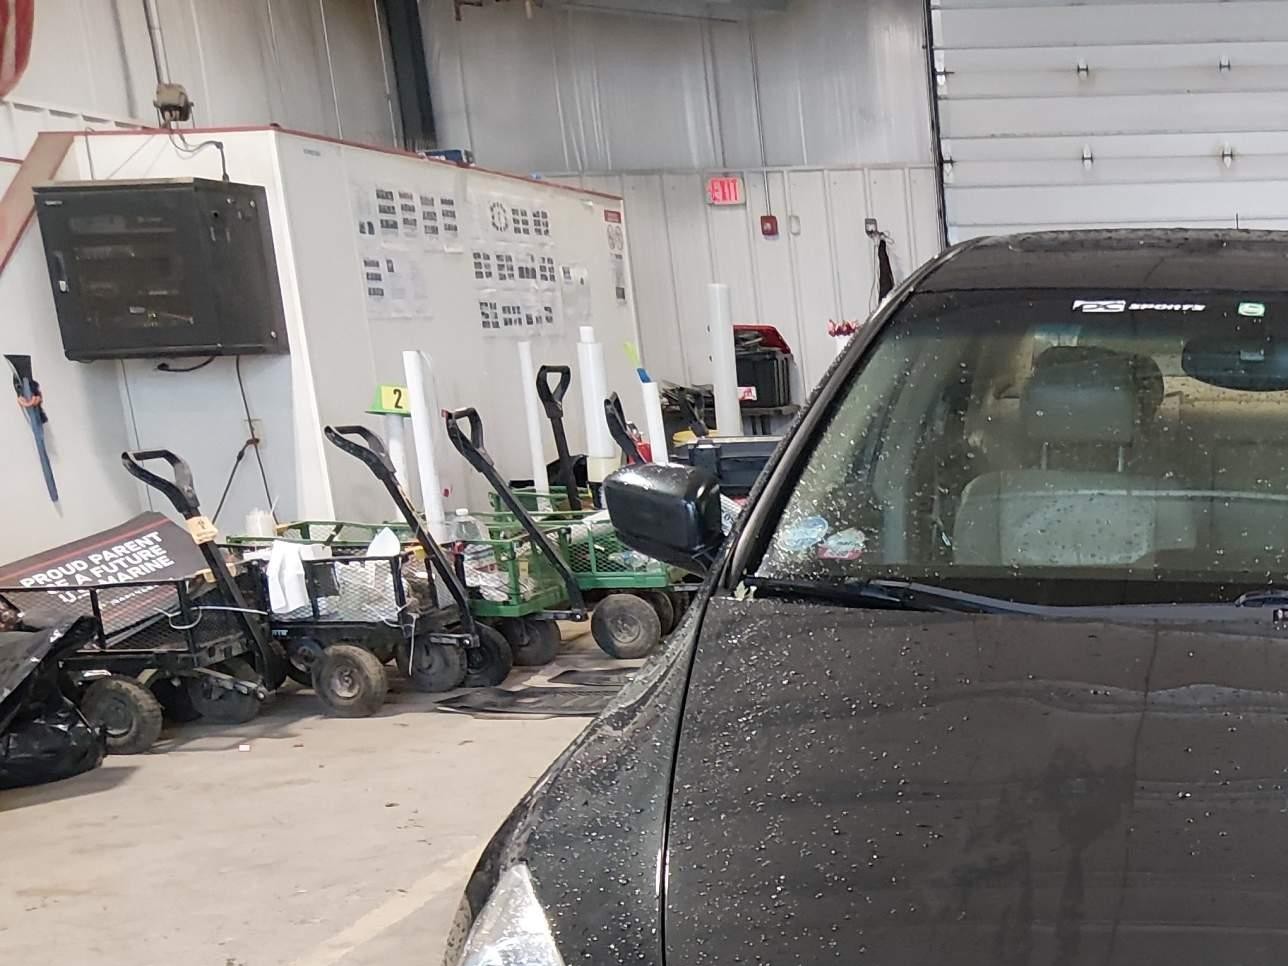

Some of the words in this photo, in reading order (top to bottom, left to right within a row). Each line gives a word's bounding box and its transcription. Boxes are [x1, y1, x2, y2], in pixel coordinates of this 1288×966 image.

[711, 177, 738, 202] EXIT
[1128, 302, 1206, 312] SPORTS
[392, 388, 403, 409] 2
[19, 559, 88, 587] PROUD
[88, 531, 163, 565] PARENT
[78, 573, 93, 586] A
[90, 544, 168, 580] FUTURE
[98, 554, 175, 585] MARINE
